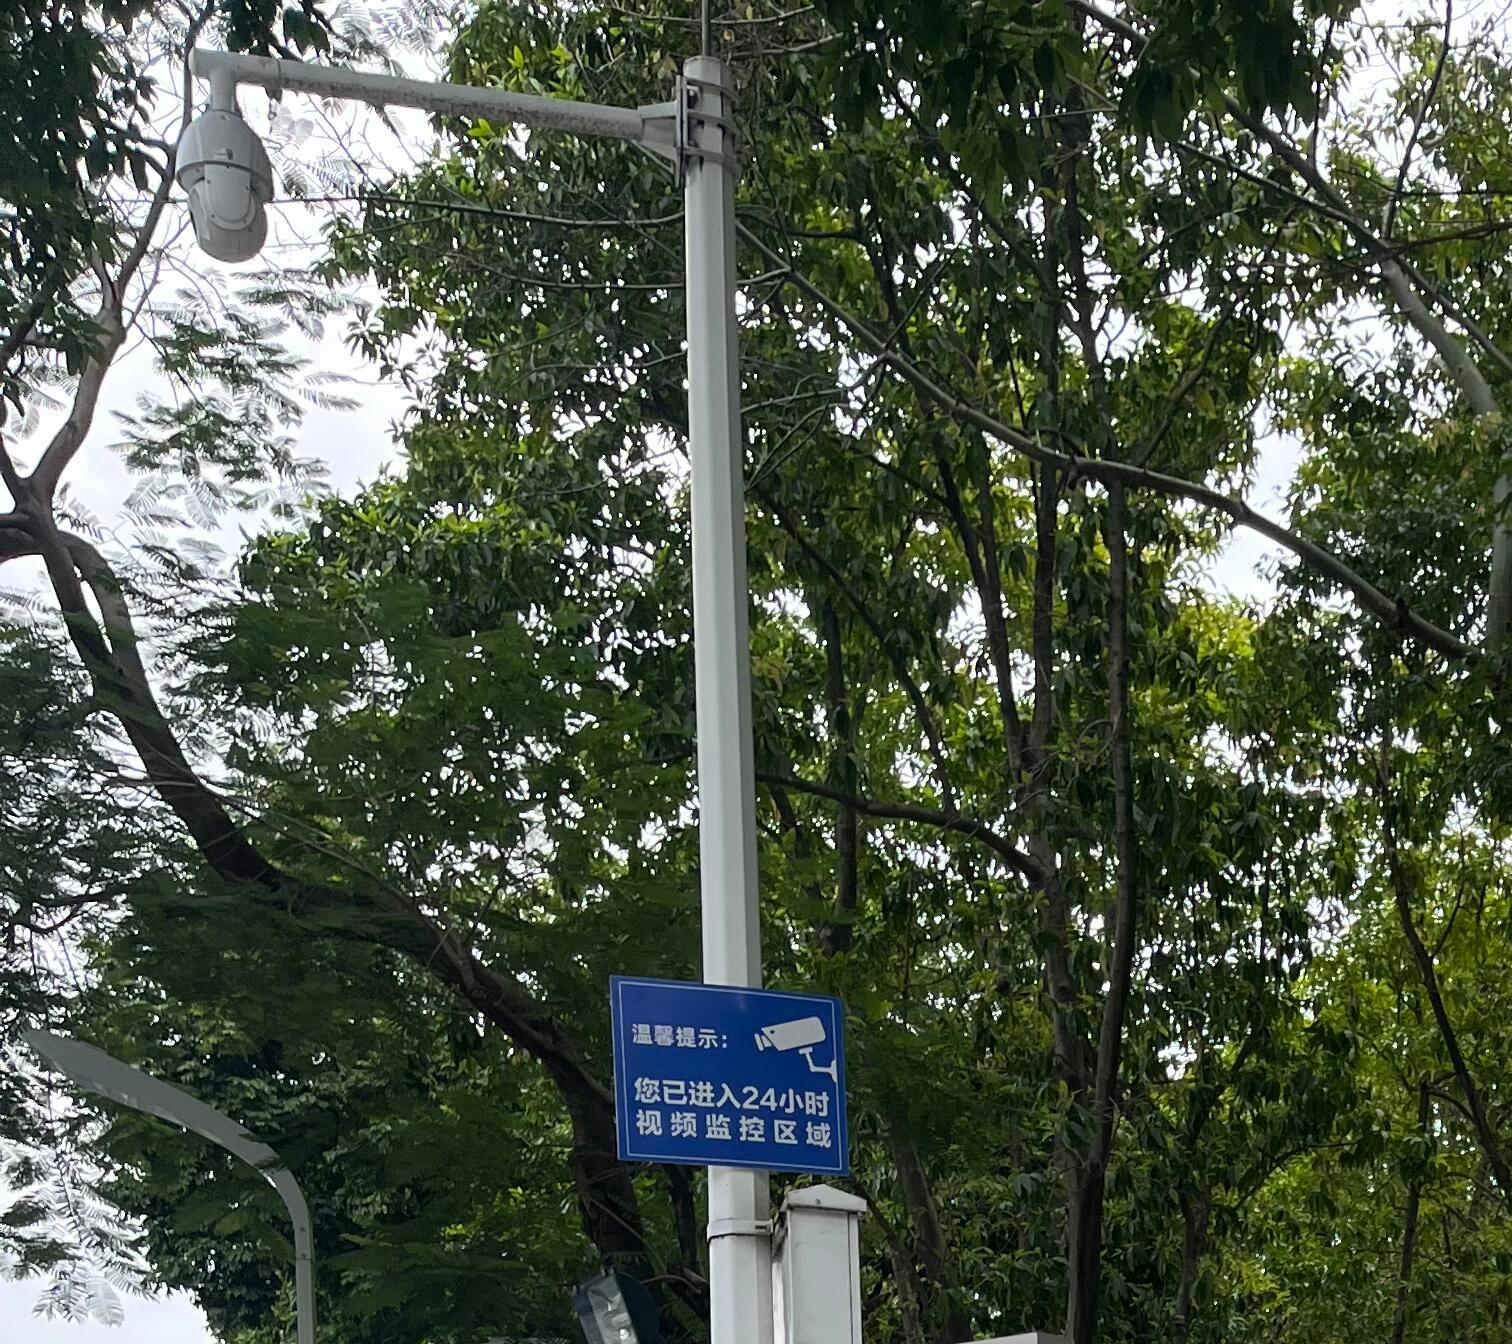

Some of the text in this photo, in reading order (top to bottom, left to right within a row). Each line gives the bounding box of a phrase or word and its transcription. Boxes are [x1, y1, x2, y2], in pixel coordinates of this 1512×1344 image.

[634, 1076, 830, 1117] 您已进入24小时
[636, 1109, 832, 1148] 视频监控区域
